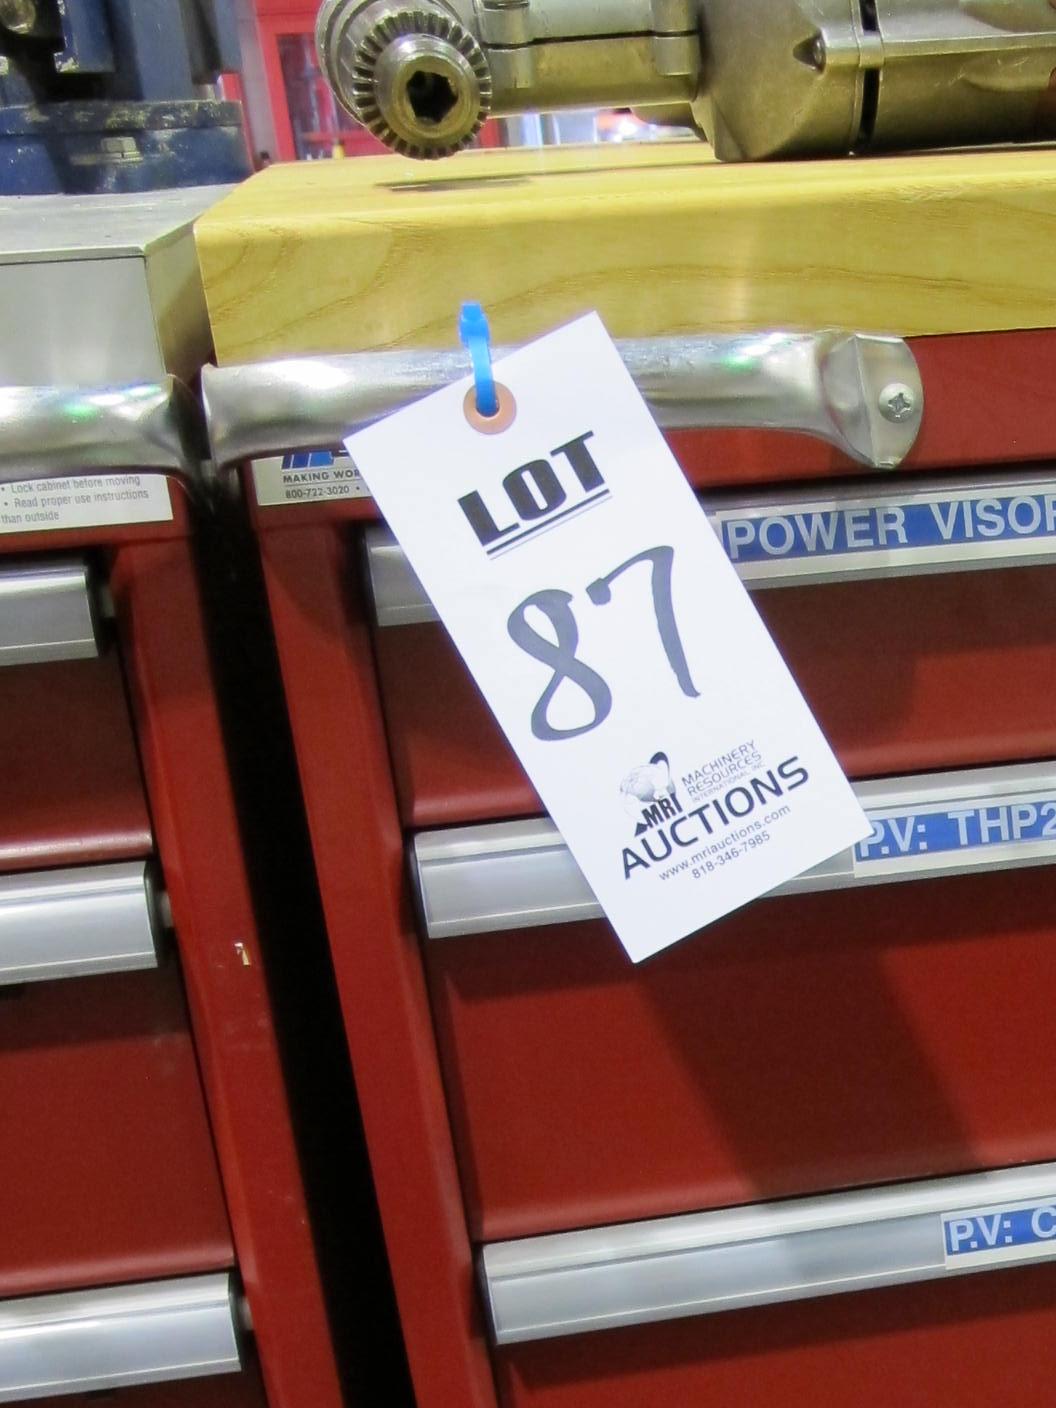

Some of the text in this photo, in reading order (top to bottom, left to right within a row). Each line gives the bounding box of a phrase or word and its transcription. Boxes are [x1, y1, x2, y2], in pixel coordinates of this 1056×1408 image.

[11, 475, 140, 494] Lock cabinet before moving
[14, 488, 149, 509] Read proper use instructions
[283, 471, 329, 484] MAKING
[285, 485, 350, 499] 800-722-3020
[457, 430, 606, 546] LOT
[25, 510, 59, 522] outside
[728, 506, 909, 559] POWER
[507, 545, 701, 742] 87
[681, 739, 756, 787] MACHINERY
[687, 750, 762, 797] RESOURCES
[692, 769, 750, 802] INTERNATIONAL
[621, 756, 809, 880] AUCTIONS
[642, 792, 683, 828] MRI
[659, 805, 791, 881] www.mriauctions.com
[692, 831, 770, 879] 818-346-7985
[949, 1213, 1014, 1252] P.V:
